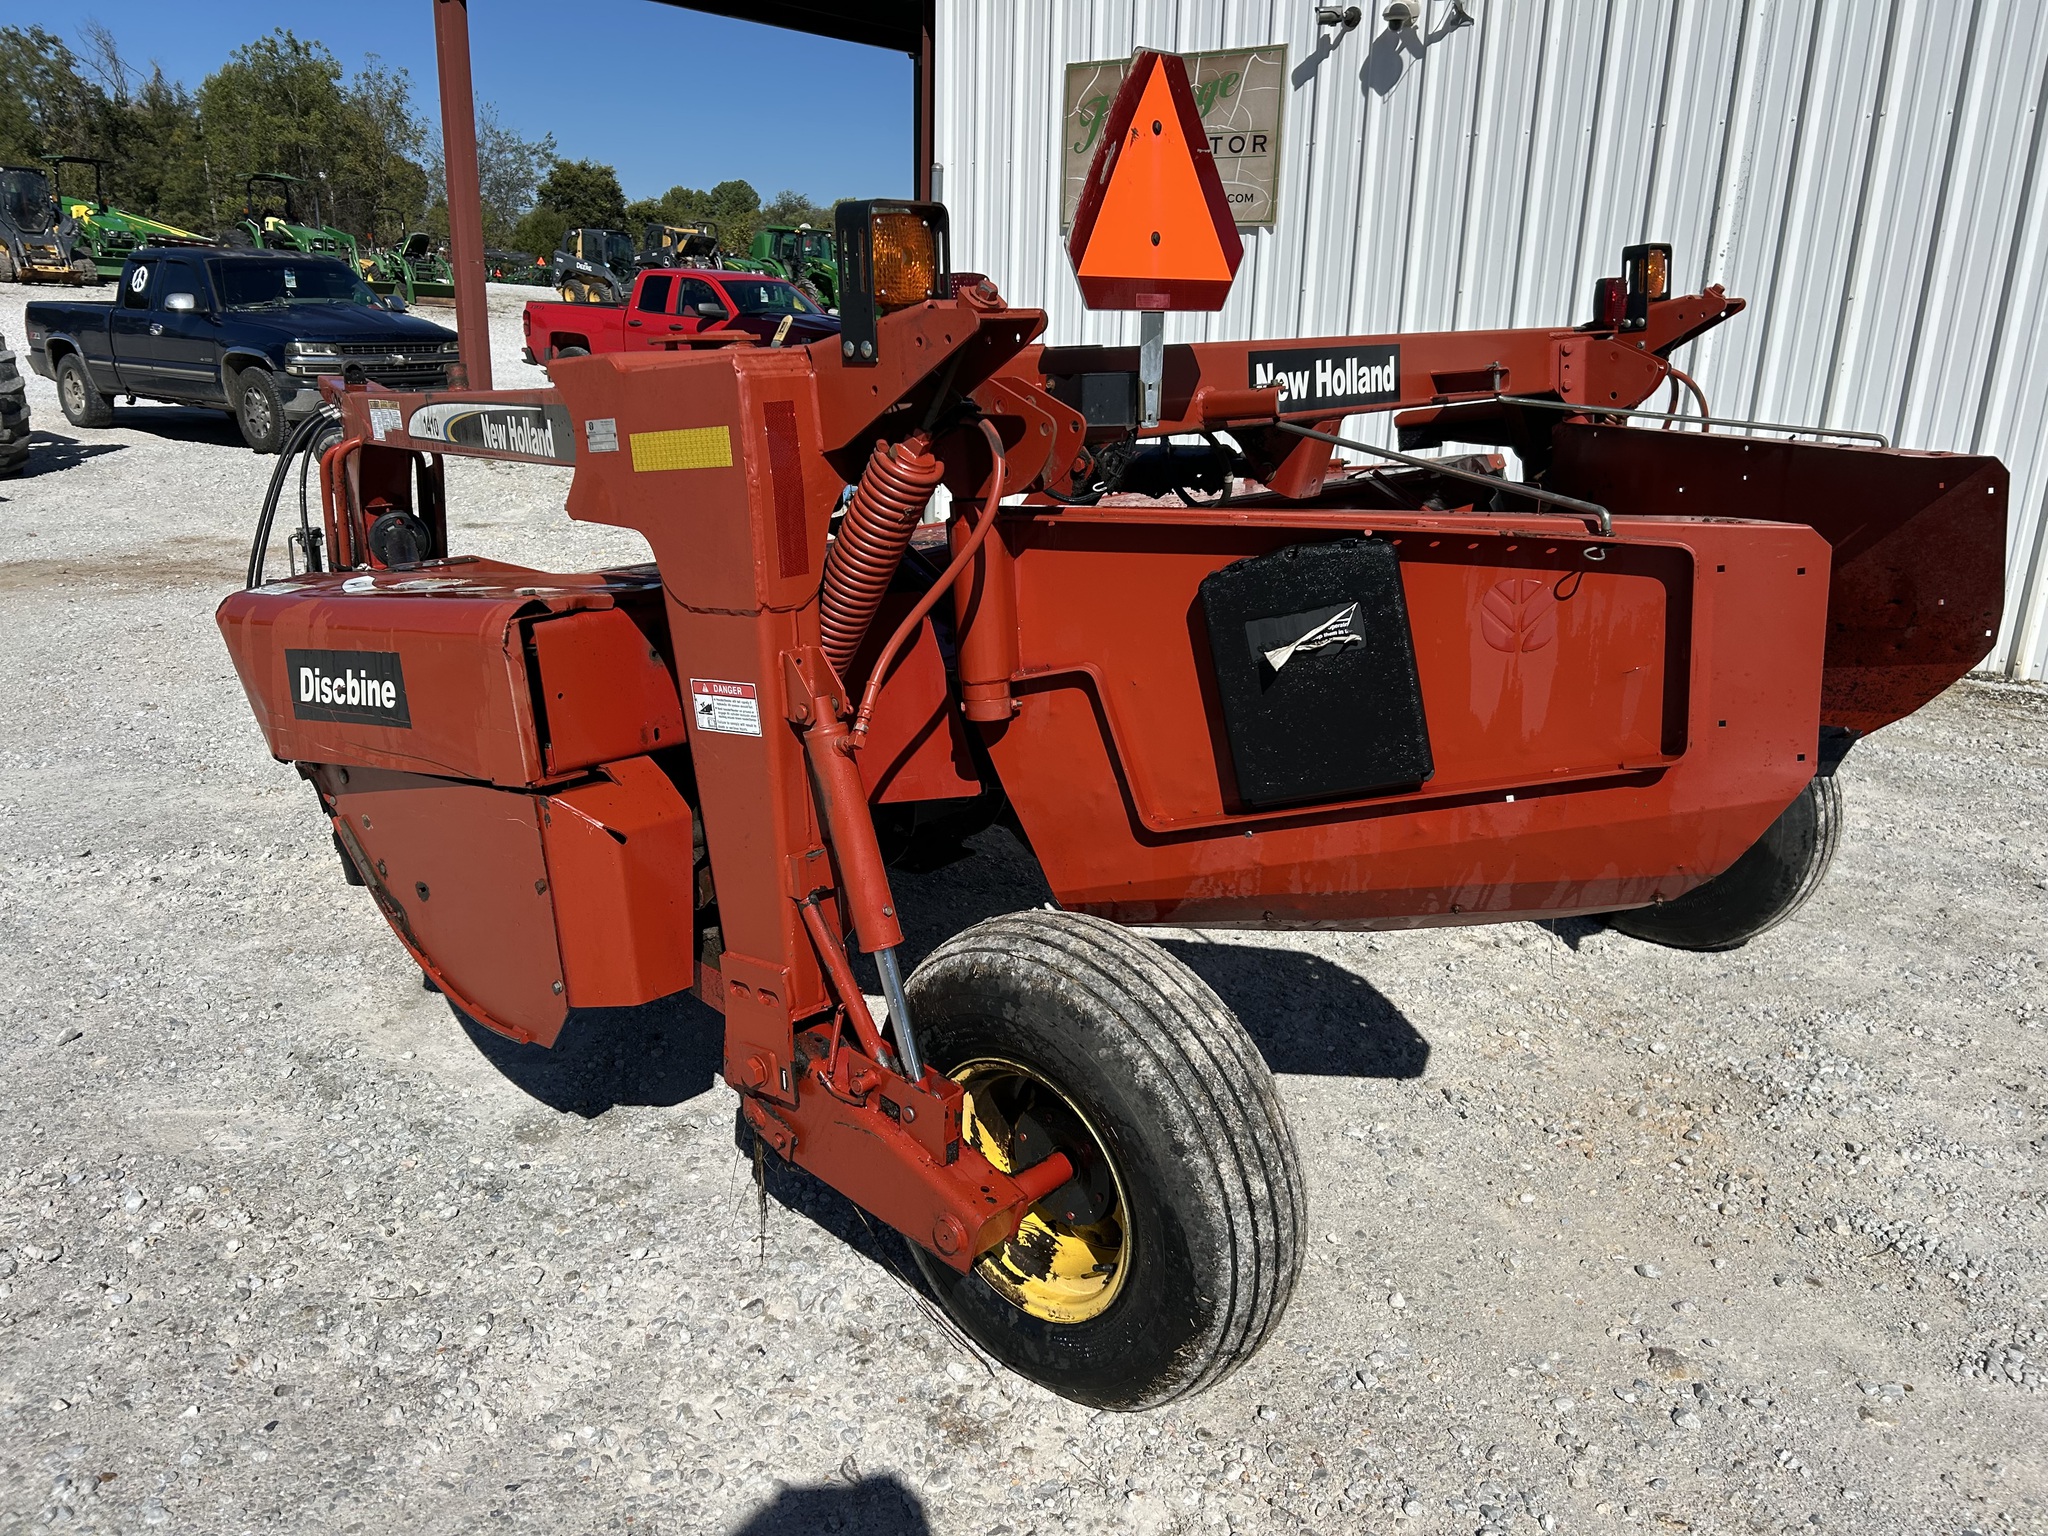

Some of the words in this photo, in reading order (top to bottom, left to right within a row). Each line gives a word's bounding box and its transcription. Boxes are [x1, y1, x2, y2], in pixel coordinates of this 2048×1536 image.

[1209, 134, 1267, 154] TOR
[1256, 362, 1310, 402] New
[1315, 355, 1395, 398] Holland
[423, 415, 440, 437] 1410
[480, 413, 507, 450] New
[506, 415, 556, 458] Holland
[299, 666, 396, 709] Discbine
[713, 684, 742, 695] DANGER
